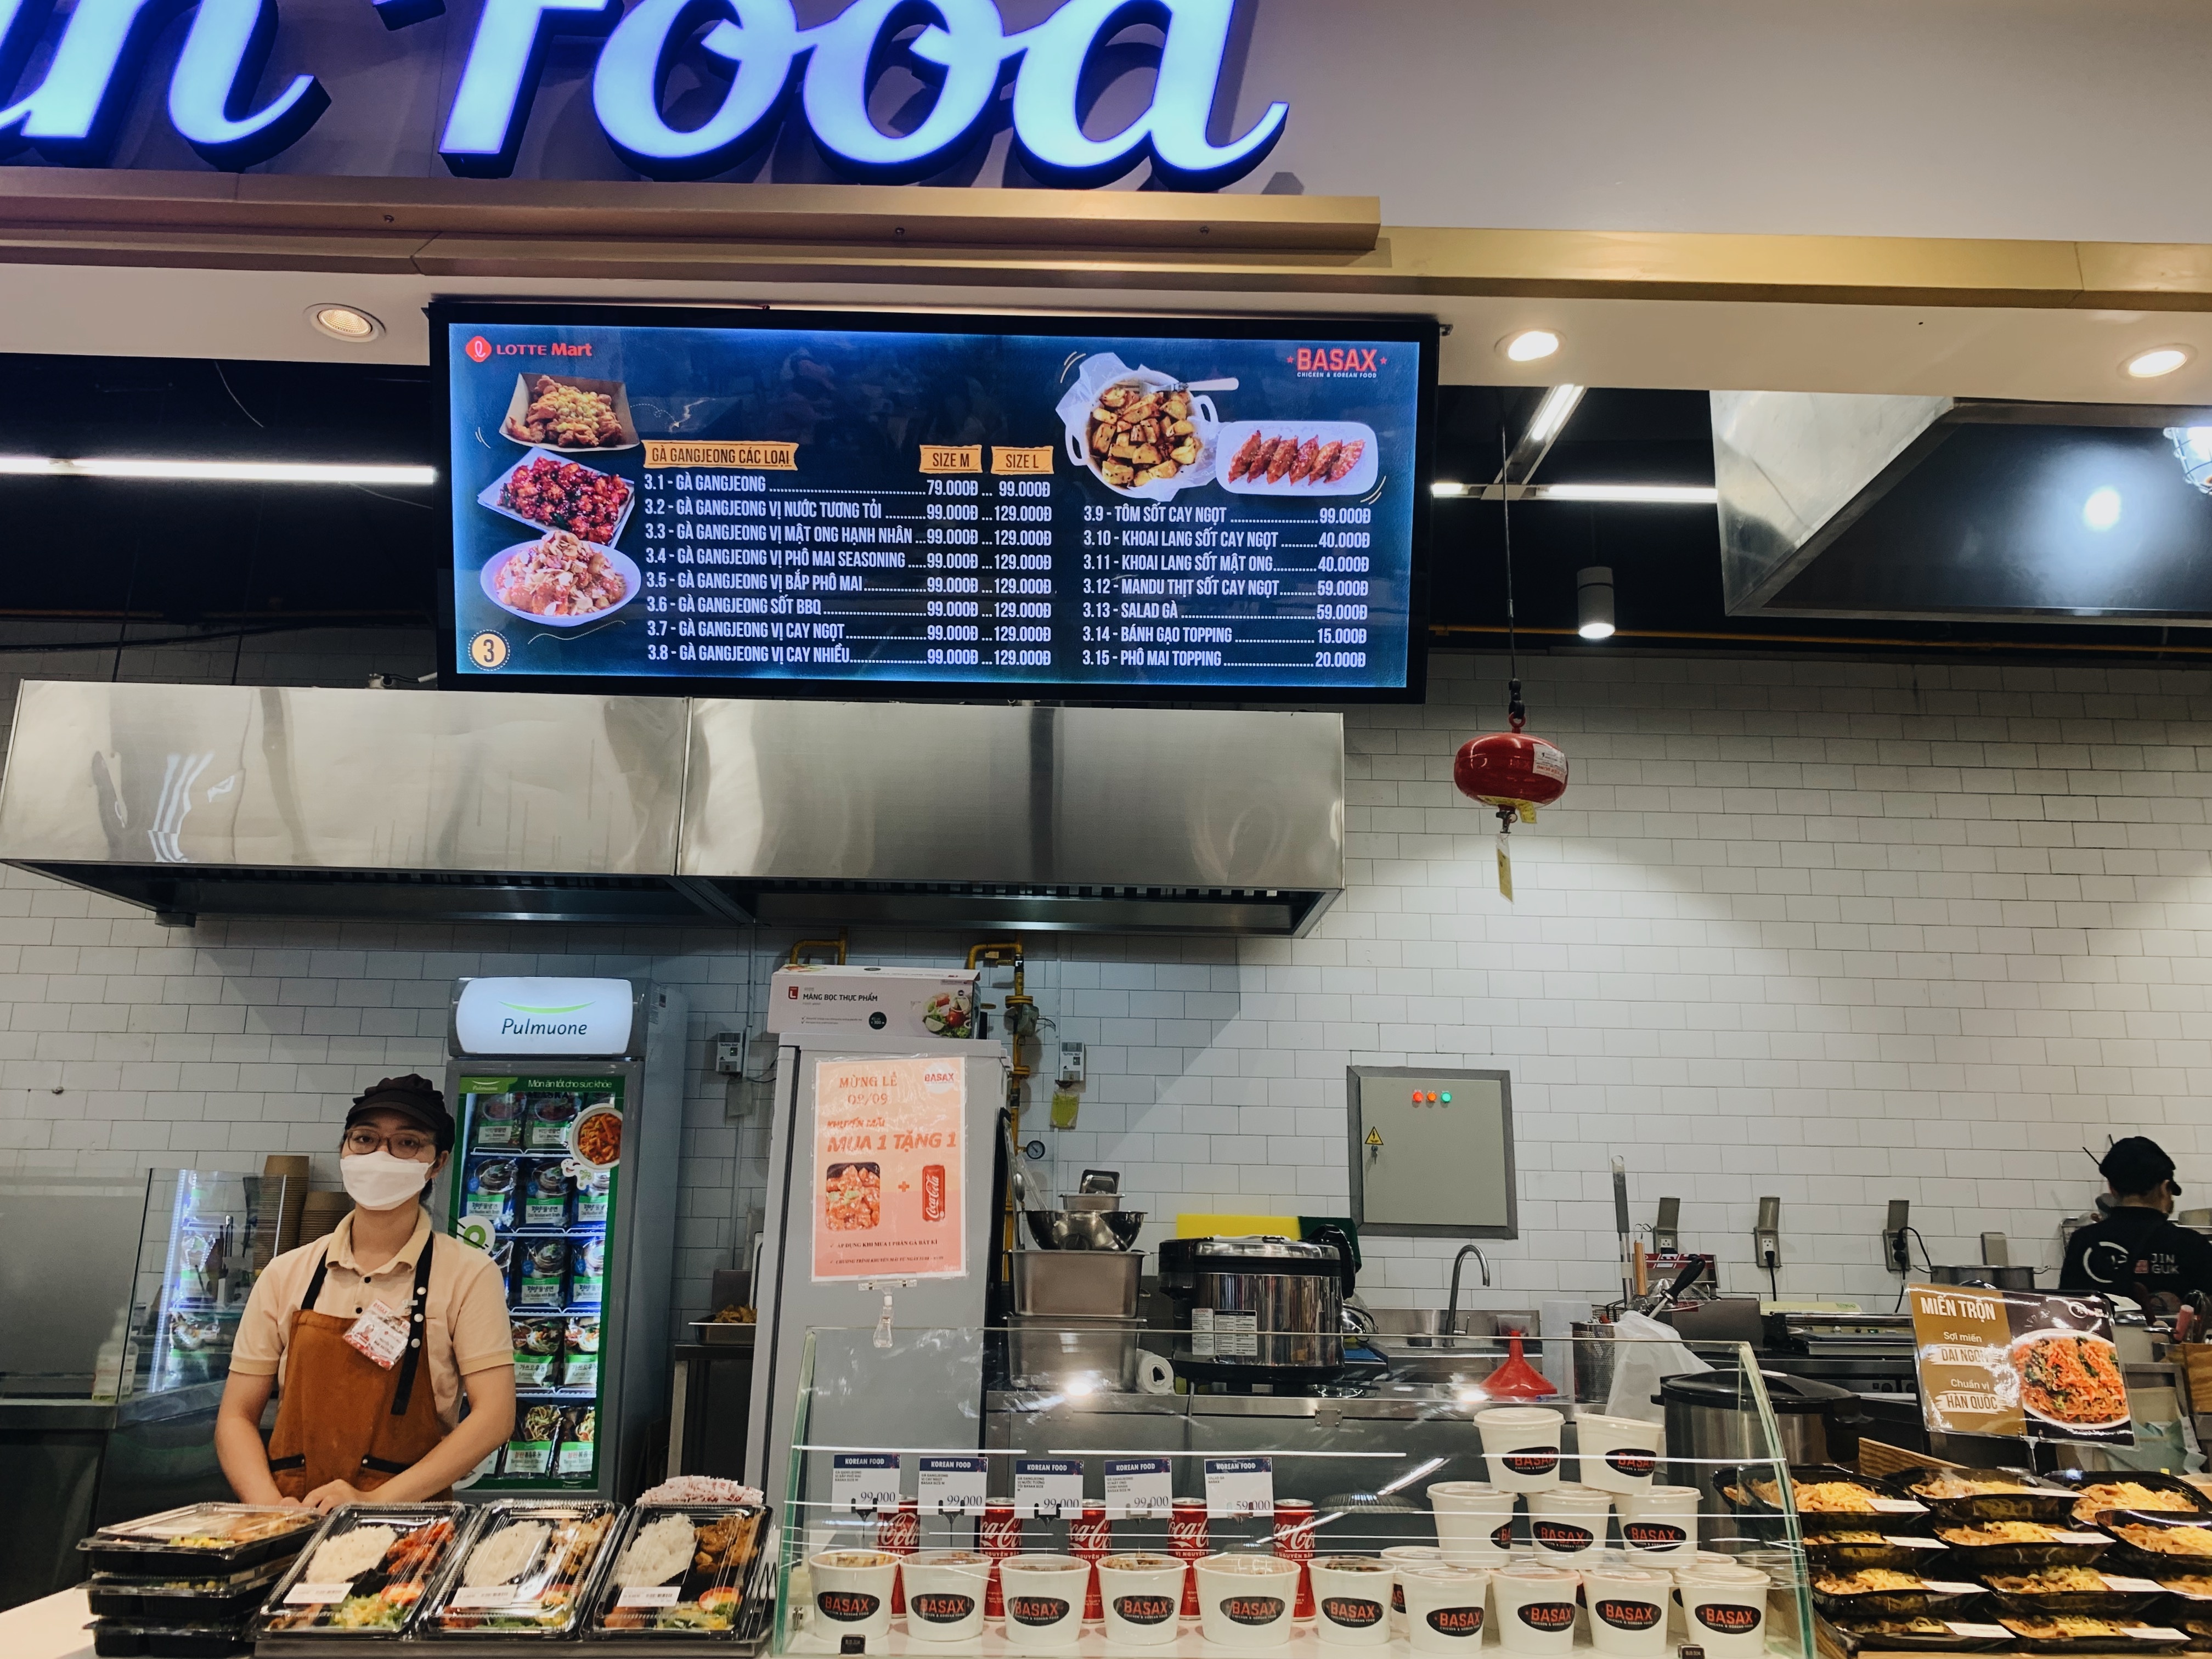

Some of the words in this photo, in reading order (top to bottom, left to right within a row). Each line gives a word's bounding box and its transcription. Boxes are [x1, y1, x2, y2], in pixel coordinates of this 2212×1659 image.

[496, 344, 546, 355] LOTTE
[551, 342, 592, 356] Mart
[1296, 348, 1377, 372] BASAX
[652, 445, 667, 462] GÀ
[670, 448, 736, 464] GANGJEONG
[739, 447, 761, 464] CÁC
[765, 449, 789, 467] LOẠI
[933, 453, 957, 467] SIZE
[960, 453, 970, 467] M
[1006, 454, 1030, 468] SIZE
[1032, 455, 1039, 469] L
[645, 473, 663, 490] 3.1
[676, 471, 692, 490] GÀ
[696, 475, 766, 492] GANGJEONG
[927, 479, 978, 495] 79.000Đ
[999, 480, 1051, 497] 99.000Đ
[645, 498, 665, 515] 3.2
[676, 496, 693, 515] GÀ
[696, 499, 766, 516] GANGJEONG
[769, 500, 781, 521] VỊ
[784, 498, 817, 517] NƯỚC
[819, 501, 860, 518] TƯƠNG
[862, 497, 882, 518] TỎI
[927, 504, 978, 520] 99.000Đ
[994, 505, 1052, 522] 129.000Đ
[1084, 506, 1103, 522] 3.9
[1114, 503, 1141, 522] TÔM
[1143, 501, 1166, 522] SỐT
[1169, 506, 1193, 522] CAY
[1195, 506, 1227, 526] NGỌT
[1319, 507, 1371, 524] 99.000Đ
[645, 522, 665, 539] 3.3
[677, 520, 693, 539] GÀ
[696, 523, 766, 540] GANGJEONG
[769, 525, 781, 545] VỊ
[785, 522, 811, 545] MẬT
[814, 526, 838, 542] ONG
[842, 526, 875, 546] HẠNH
[878, 524, 912, 543] NHÂN
[927, 528, 978, 544] 99.000Đ
[994, 529, 1052, 546] 129.000Đ
[1084, 530, 1111, 546] 3.10
[1122, 530, 1159, 546] KHOAI
[1161, 531, 1193, 546] LANG
[1195, 526, 1218, 547] SỐT
[1220, 531, 1245, 547] CAY
[1247, 531, 1279, 550] NGỌT
[1318, 532, 1370, 548] 40.000Đ
[1083, 578, 1110, 594] 3.12
[1121, 578, 1165, 595] MANDU
[1167, 579, 1194, 599] THỊT
[1196, 574, 1220, 595] SỐT
[1222, 579, 1246, 595] CAY
[1248, 579, 1280, 599] NGỌT
[1317, 579, 1369, 596] 59.000Đ
[647, 596, 667, 612] 3.6
[678, 594, 695, 612] GÀ
[698, 596, 768, 613] GANGJEONG
[770, 593, 794, 614] SỐT
[797, 598, 821, 614] BBQ
[927, 600, 978, 617] 99.000Đ
[994, 601, 1051, 618] 129.000Đ
[1083, 602, 1109, 618] 3.13
[1121, 602, 1159, 618] SALAD
[1162, 600, 1178, 619] GÀ
[1317, 603, 1368, 620] 59.000Đ
[1082, 626, 1110, 642] 3.14
[1121, 623, 1154, 642] BÁNH
[1156, 627, 1180, 646] GẠO
[1182, 627, 1232, 643] TOPPING
[1317, 627, 1367, 644] 15.000Đ
[483, 639, 494, 663] 3
[648, 645, 668, 661] 3.8
[679, 642, 696, 661] GÀ
[698, 645, 769, 662] GANGJEONG
[771, 646, 783, 666] VỊ
[786, 646, 811, 662] CAY
[813, 642, 850, 663] NHIỀU
[927, 648, 978, 664] 99.000Đ
[994, 649, 1051, 665] 129.000Đ
[1082, 650, 1109, 666] 3.15
[1120, 647, 1144, 666] PHÔ
[1147, 650, 1169, 666] MAI
[1172, 650, 1222, 667] TOPPING
[1316, 651, 1366, 667] 20.000Đ
[824, 994, 838, 1002] BỌC
[839, 994, 857, 1003] THỰC
[501, 1018, 588, 1035] Pulmuone
[565, 1080, 579, 1088] cho
[839, 1074, 878, 1088] MỪNG
[924, 1073, 955, 1082] BASAX
[827, 1135, 872, 1153] MUA
[877, 1134, 887, 1150] 1
[894, 1130, 943, 1153] TẶNG
[946, 1131, 957, 1148] 1
[2151, 1253, 2175, 1263] JIN
[2152, 1264, 2180, 1274] GUK
[1920, 1295, 1957, 1317] MIẾN
[1957, 1298, 1996, 1323] TRỘN
[1943, 1331, 1958, 1341] Sợi
[1960, 1333, 1983, 1343] miến
[1941, 1348, 1959, 1362] DAI
[860, 1492, 896, 1503] 99000
[946, 1495, 983, 1506] 99000
[1043, 1498, 1080, 1509] 99000
[1134, 1496, 1169, 1508] 99000
[1236, 1500, 1270, 1510] 59000
[1540, 1527, 1585, 1545] BASAX
[1630, 1526, 1675, 1542] BASAX
[825, 1596, 870, 1613] BASAX
[919, 1598, 965, 1614] BASAX
[1014, 1601, 1058, 1617] BASAX
[1124, 1600, 1167, 1615] BASAX
[1231, 1600, 1277, 1616] BASAX
[1330, 1601, 1375, 1618] BASAX
[1605, 1603, 1652, 1622] BASAX
[1438, 1612, 1480, 1628] BASAX
[1531, 1607, 1572, 1622] BASAX
[1706, 1607, 1753, 1625] BASAX
